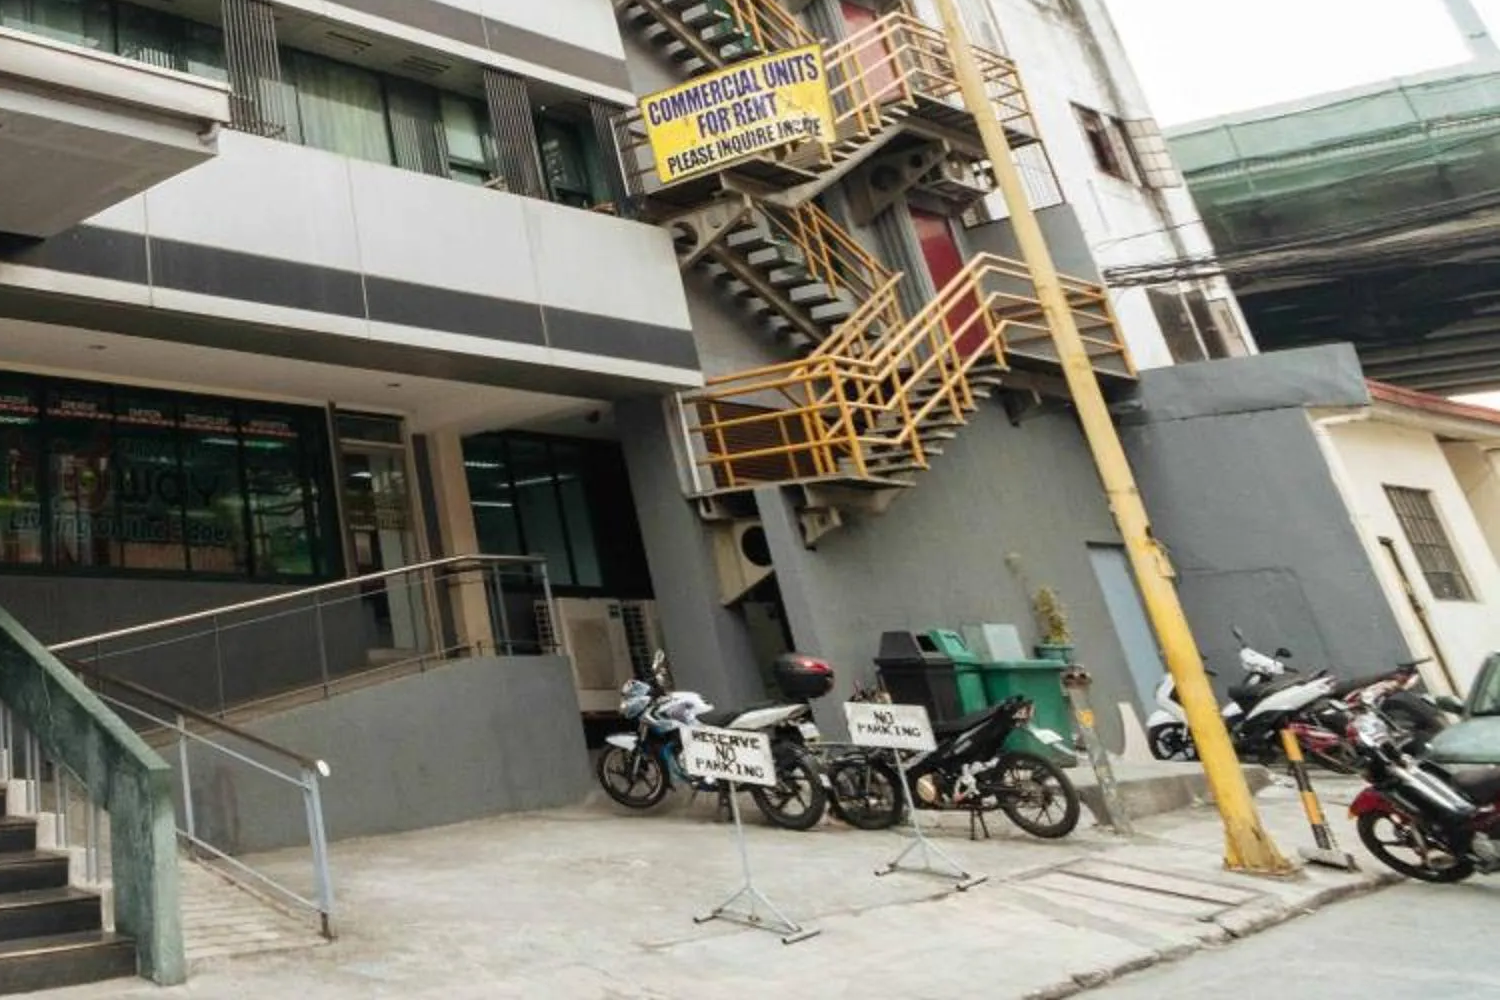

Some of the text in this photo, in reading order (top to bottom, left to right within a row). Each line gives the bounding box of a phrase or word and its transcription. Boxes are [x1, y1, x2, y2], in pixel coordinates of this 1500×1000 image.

[648, 53, 819, 125] COMMERCIAL UNITS
[697, 92, 778, 138] FOR RENT
[667, 144, 716, 176] PLEASE
[717, 127, 775, 157] INQUIRE
[873, 711, 894, 725] NO
[857, 723, 921, 737] PARKING
[716, 745, 736, 763] NO
[696, 757, 764, 778] PARKING
